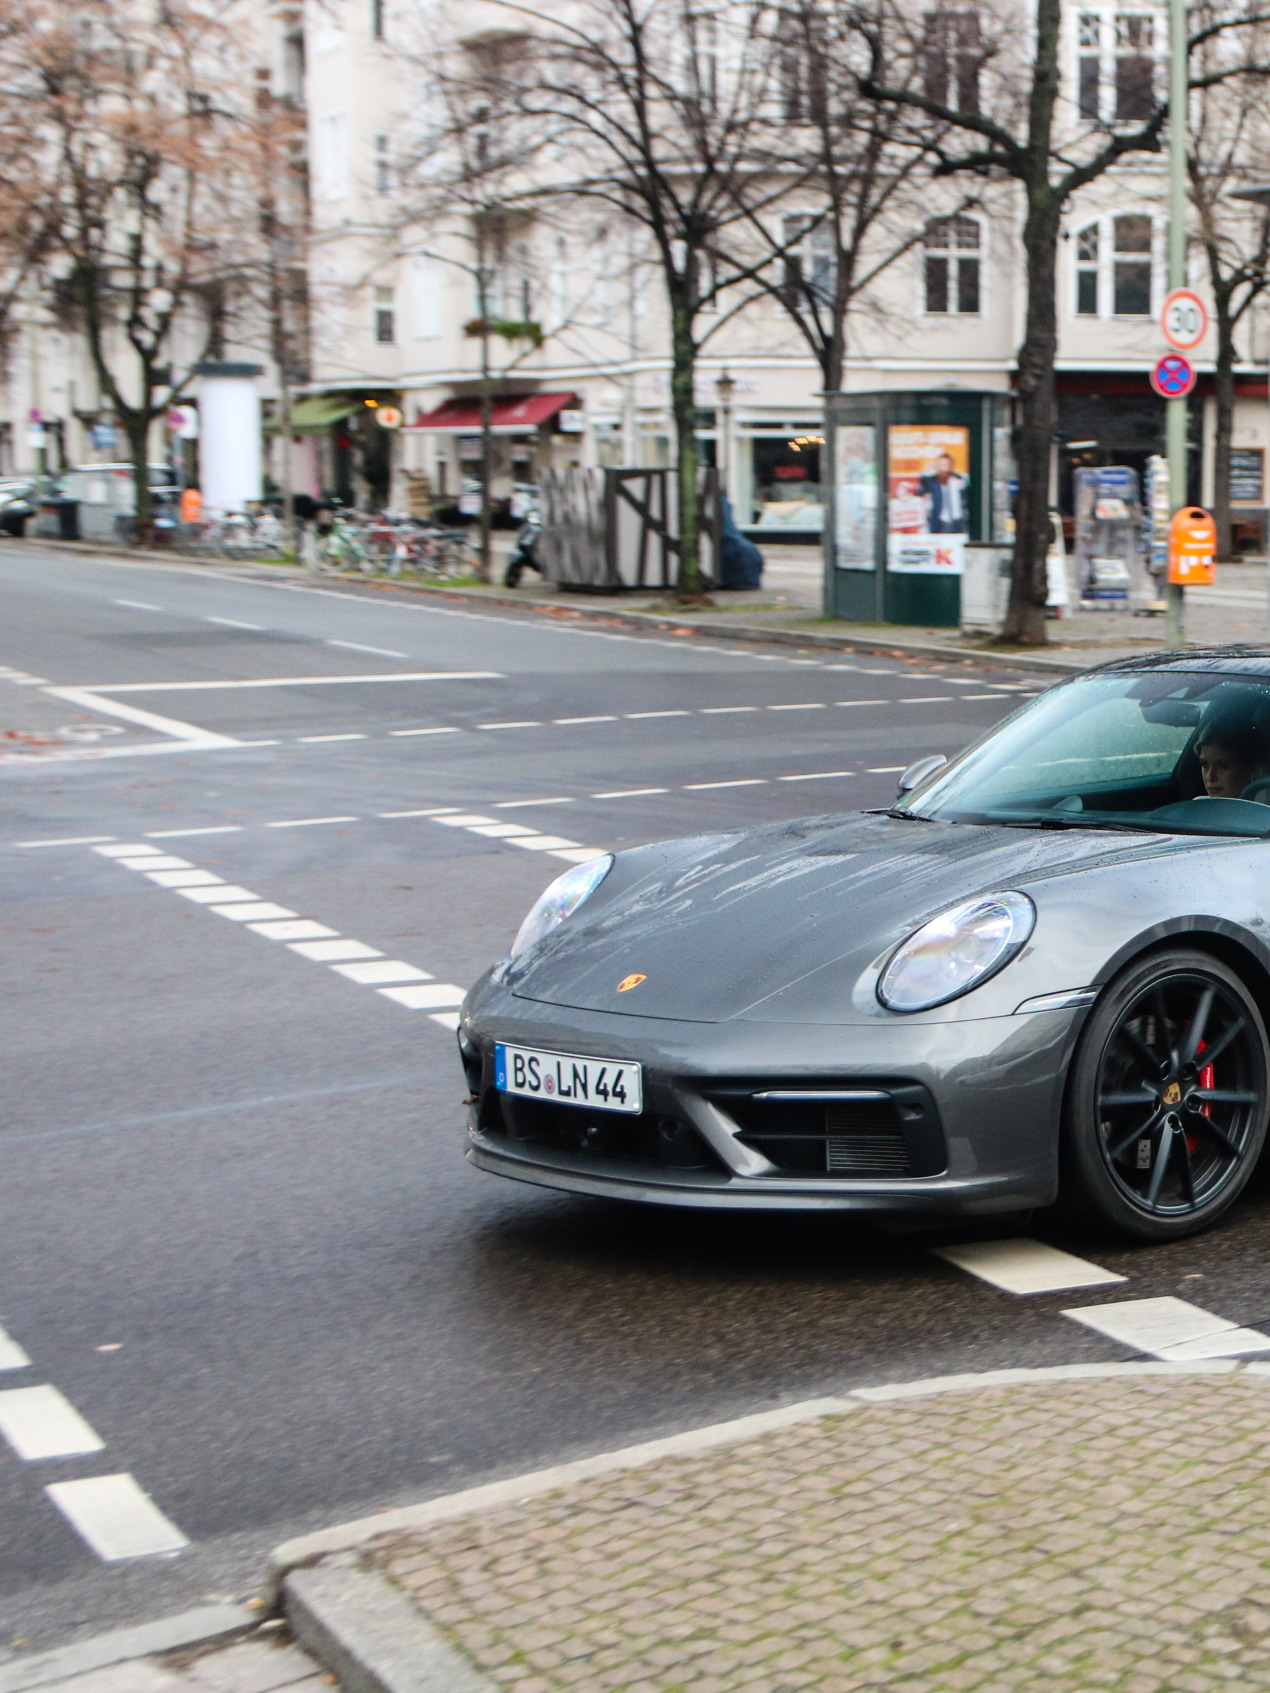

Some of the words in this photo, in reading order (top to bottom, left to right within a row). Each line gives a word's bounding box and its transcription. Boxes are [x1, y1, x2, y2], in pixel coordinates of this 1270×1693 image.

[1172, 306, 1200, 333] 30
[513, 1053, 541, 1092] BS
[557, 1060, 589, 1100] LN
[595, 1067, 627, 1104] 44
